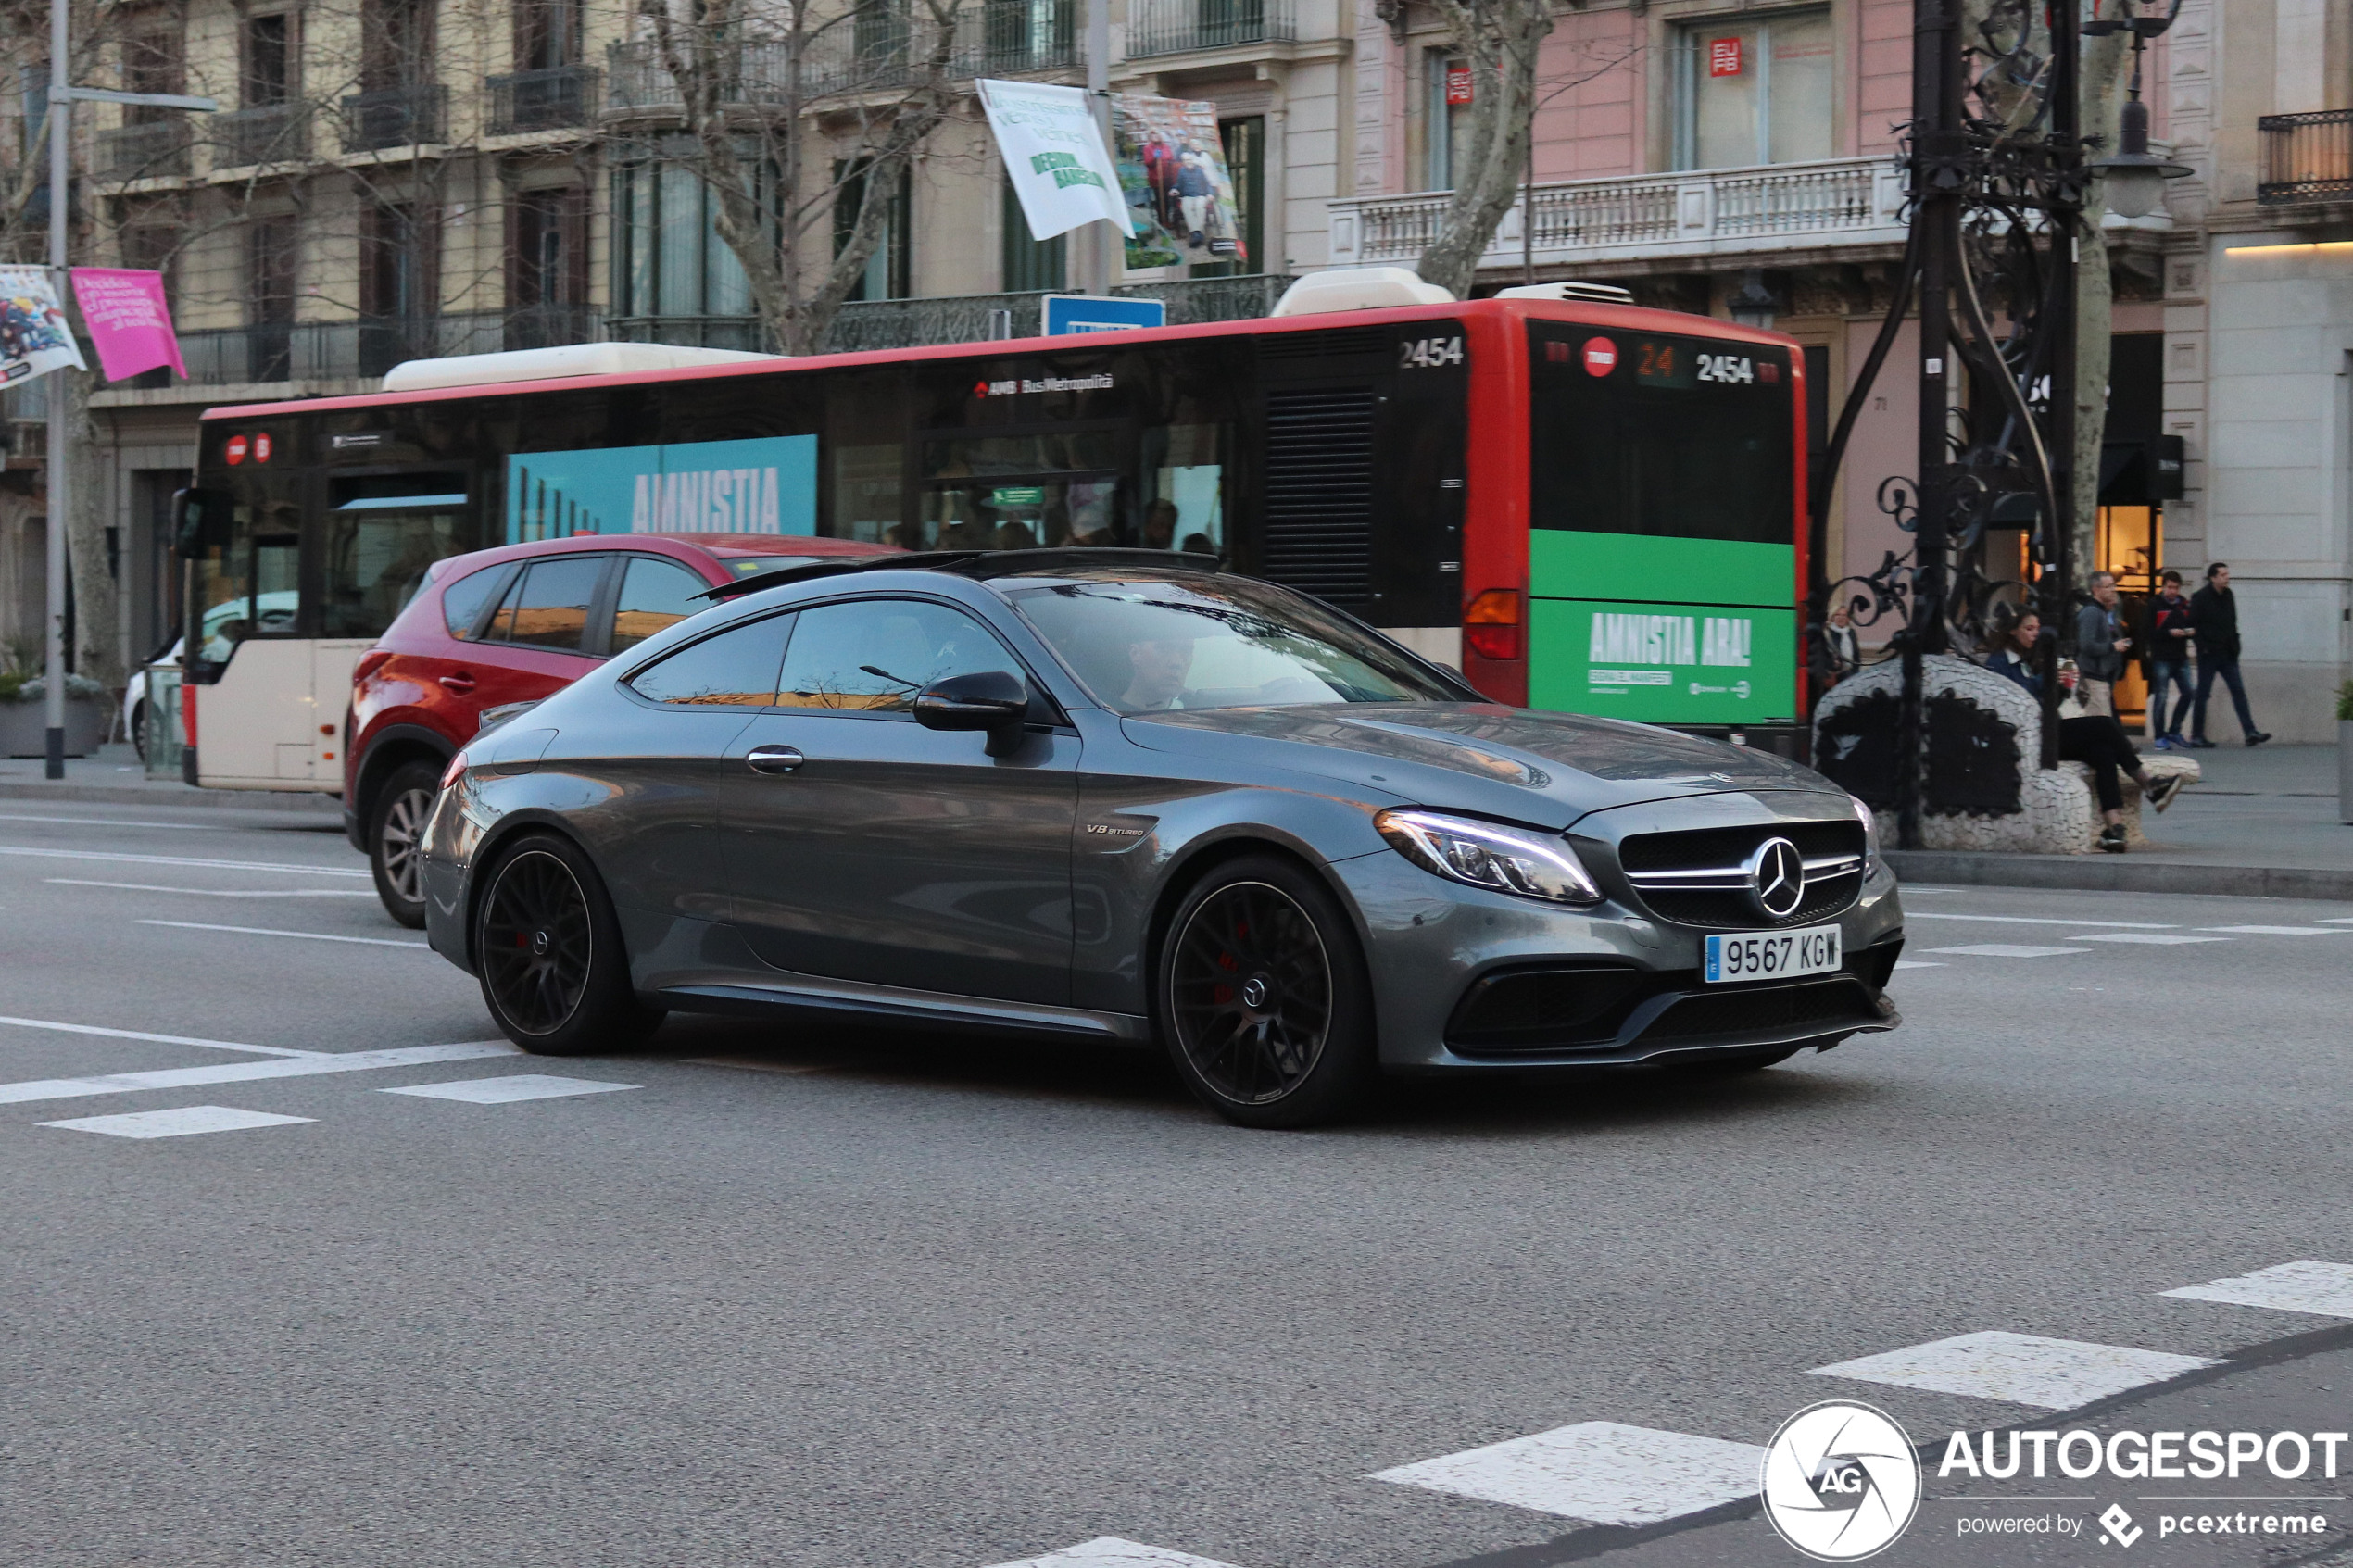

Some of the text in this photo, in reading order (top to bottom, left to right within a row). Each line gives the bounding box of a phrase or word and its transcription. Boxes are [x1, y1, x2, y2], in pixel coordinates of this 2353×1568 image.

[1714, 43, 1739, 57] EU
[1714, 57, 1739, 73] FB
[1401, 336, 1464, 369] 2454
[1638, 343, 1674, 379] 24
[1696, 354, 1754, 384] 2454
[1021, 379, 1044, 393] Bus
[1701, 617, 1752, 667] ARA!
[1087, 824, 1108, 834] V8
[1728, 932, 1837, 974] 9567 KGW
